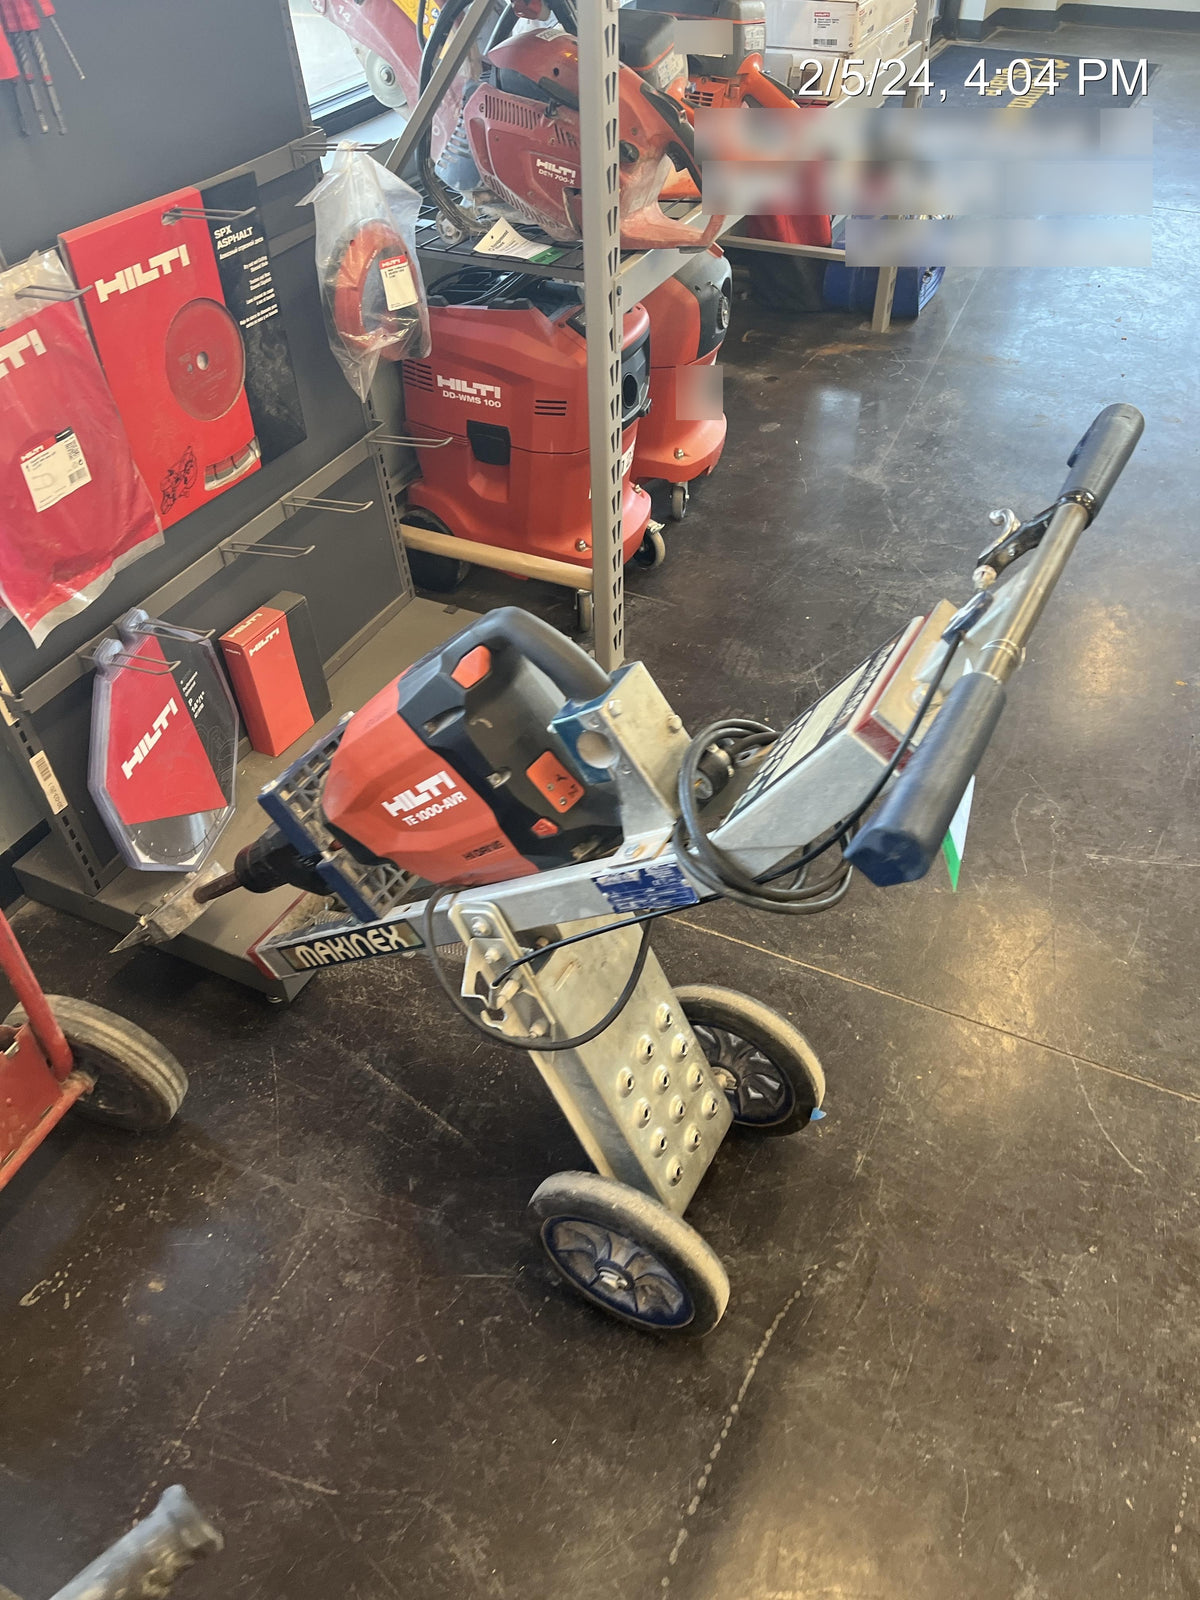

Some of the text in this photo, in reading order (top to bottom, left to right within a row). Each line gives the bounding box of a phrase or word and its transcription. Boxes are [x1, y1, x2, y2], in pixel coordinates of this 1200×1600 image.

[536, 158, 576, 179] HILTI
[213, 224, 232, 240] SPX
[217, 226, 254, 250] ASPHALT
[94, 243, 191, 304] HILTI
[436, 374, 501, 399] HILTI
[442, 389, 502, 409] DD-WMS 100
[248, 627, 279, 657] HILTI
[121, 696, 178, 780] HILTI
[381, 770, 457, 817] HILTI
[402, 791, 468, 827] TE 1000-AVR
[295, 925, 409, 968] MAKINEX
